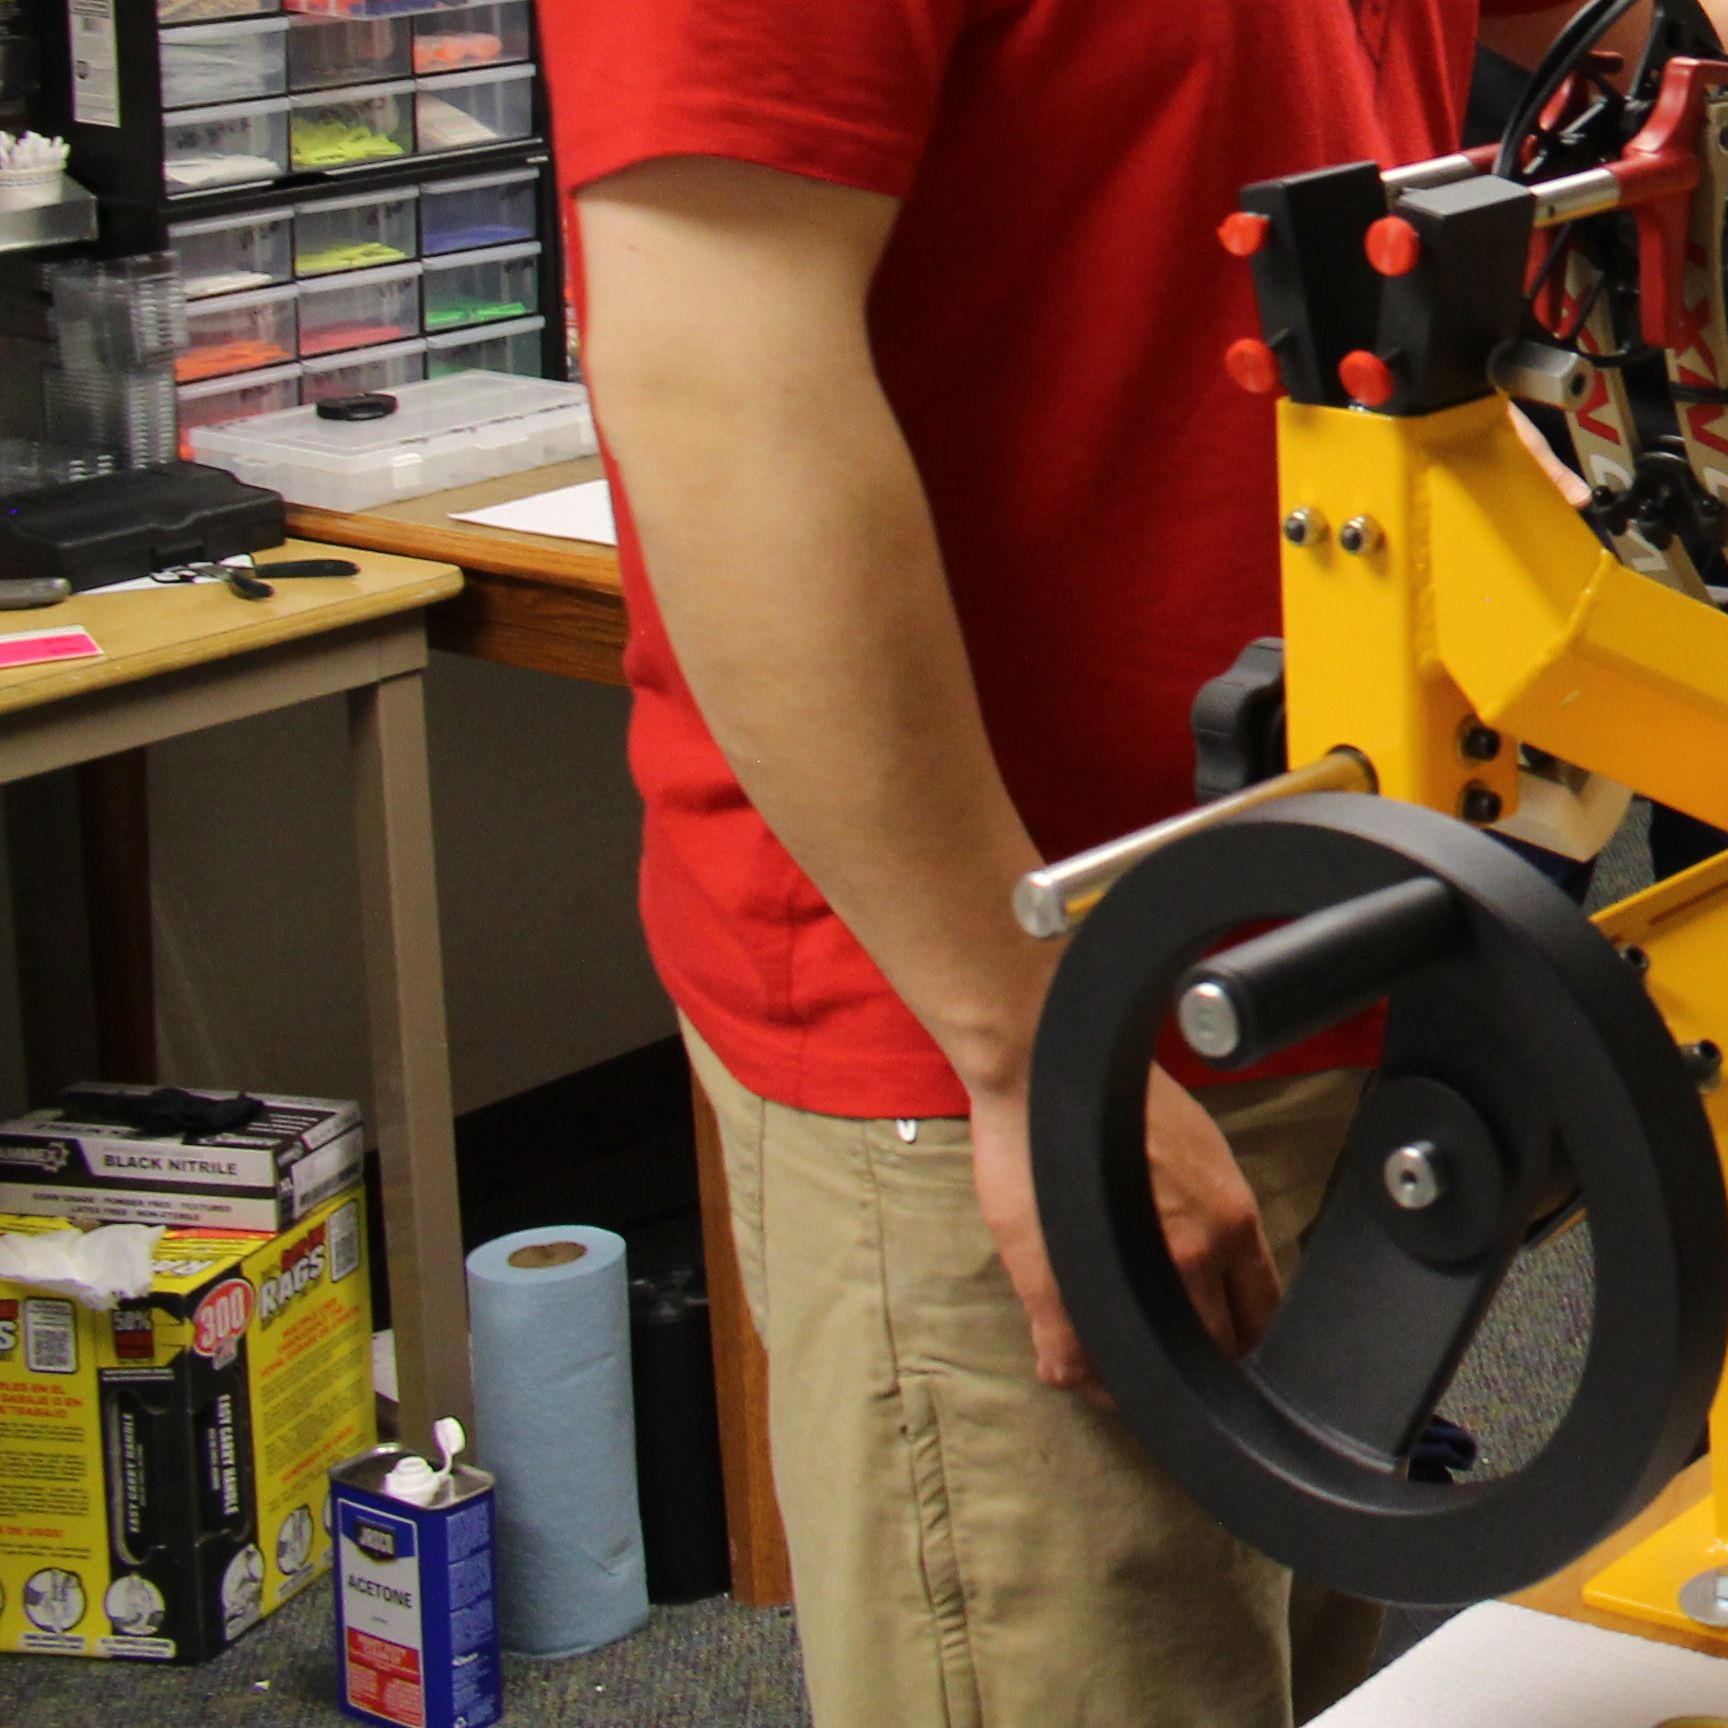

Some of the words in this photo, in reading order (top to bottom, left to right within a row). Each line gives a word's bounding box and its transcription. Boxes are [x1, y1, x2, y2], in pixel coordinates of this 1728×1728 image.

[103, 1154, 162, 1172] BLACK
[168, 1157, 238, 1176] NITRILE
[260, 1243, 326, 1318] RAGS
[200, 1286, 246, 1347] 300
[347, 1575, 413, 1609] ACETONE
